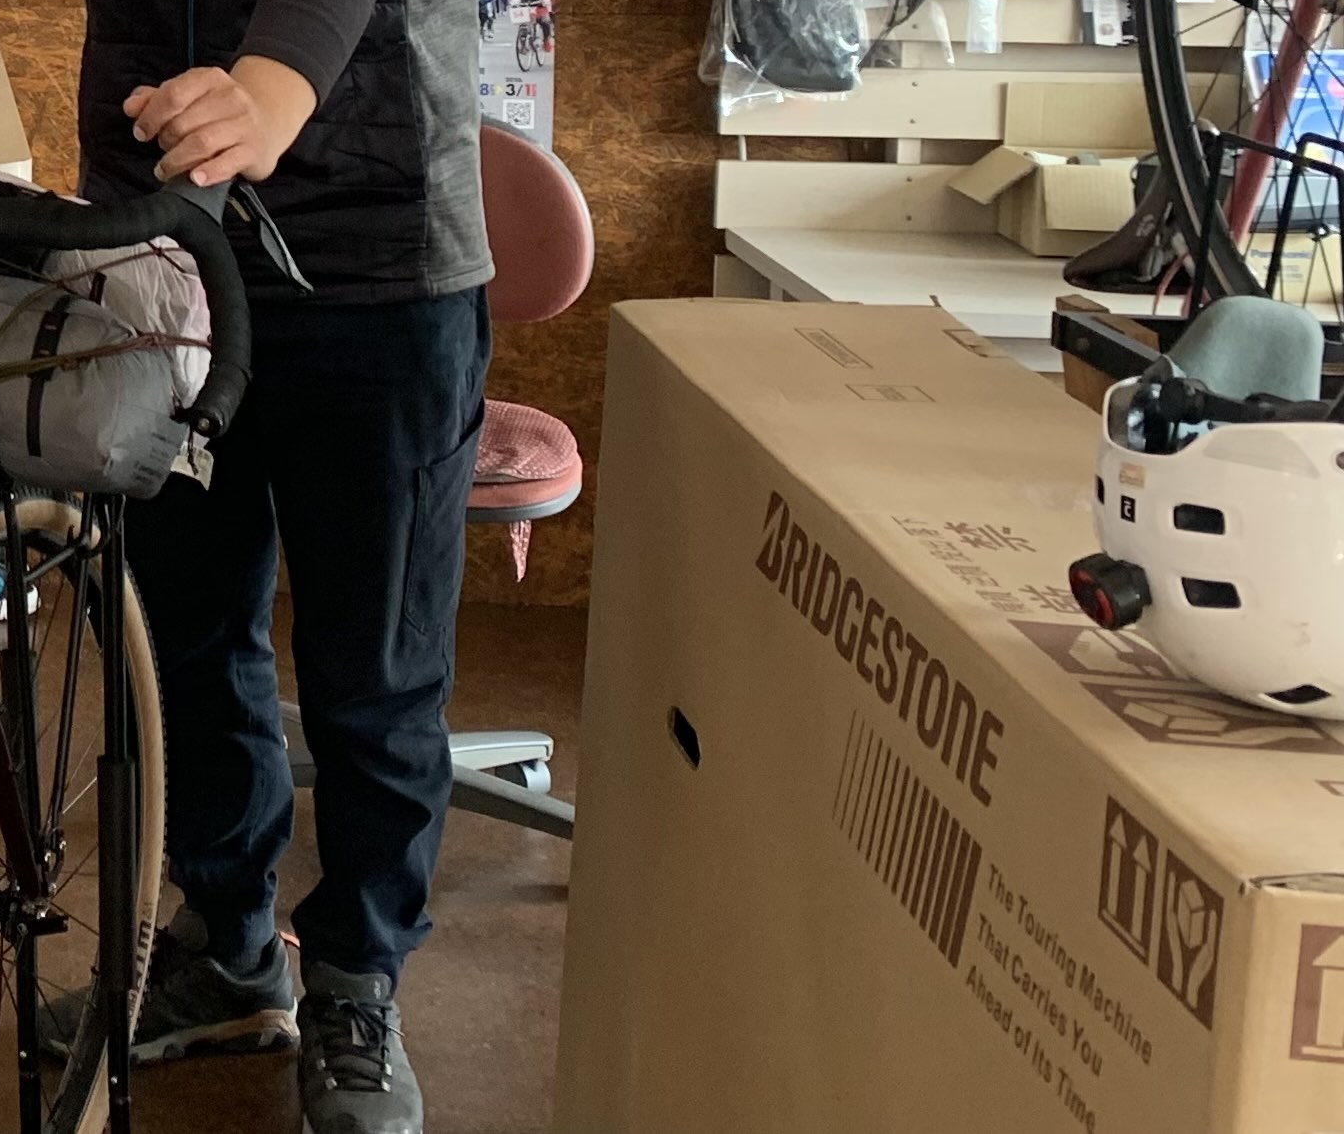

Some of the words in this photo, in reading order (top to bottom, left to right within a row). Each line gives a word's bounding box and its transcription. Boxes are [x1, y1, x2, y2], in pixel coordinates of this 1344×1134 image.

[755, 489, 1004, 808] BRIDGESTONE
[965, 965, 1013, 1034] Ahead
[1014, 1026, 1032, 1056] of
[1032, 1039, 1052, 1084] Its
[1057, 1067, 1096, 1134] Time
[978, 912, 1010, 971] That
[1011, 954, 1067, 1037] Carries
[1071, 1018, 1103, 1078] You
[989, 863, 1014, 914] The
[1017, 894, 1077, 989] Touring
[1079, 964, 1152, 1066] Machine
